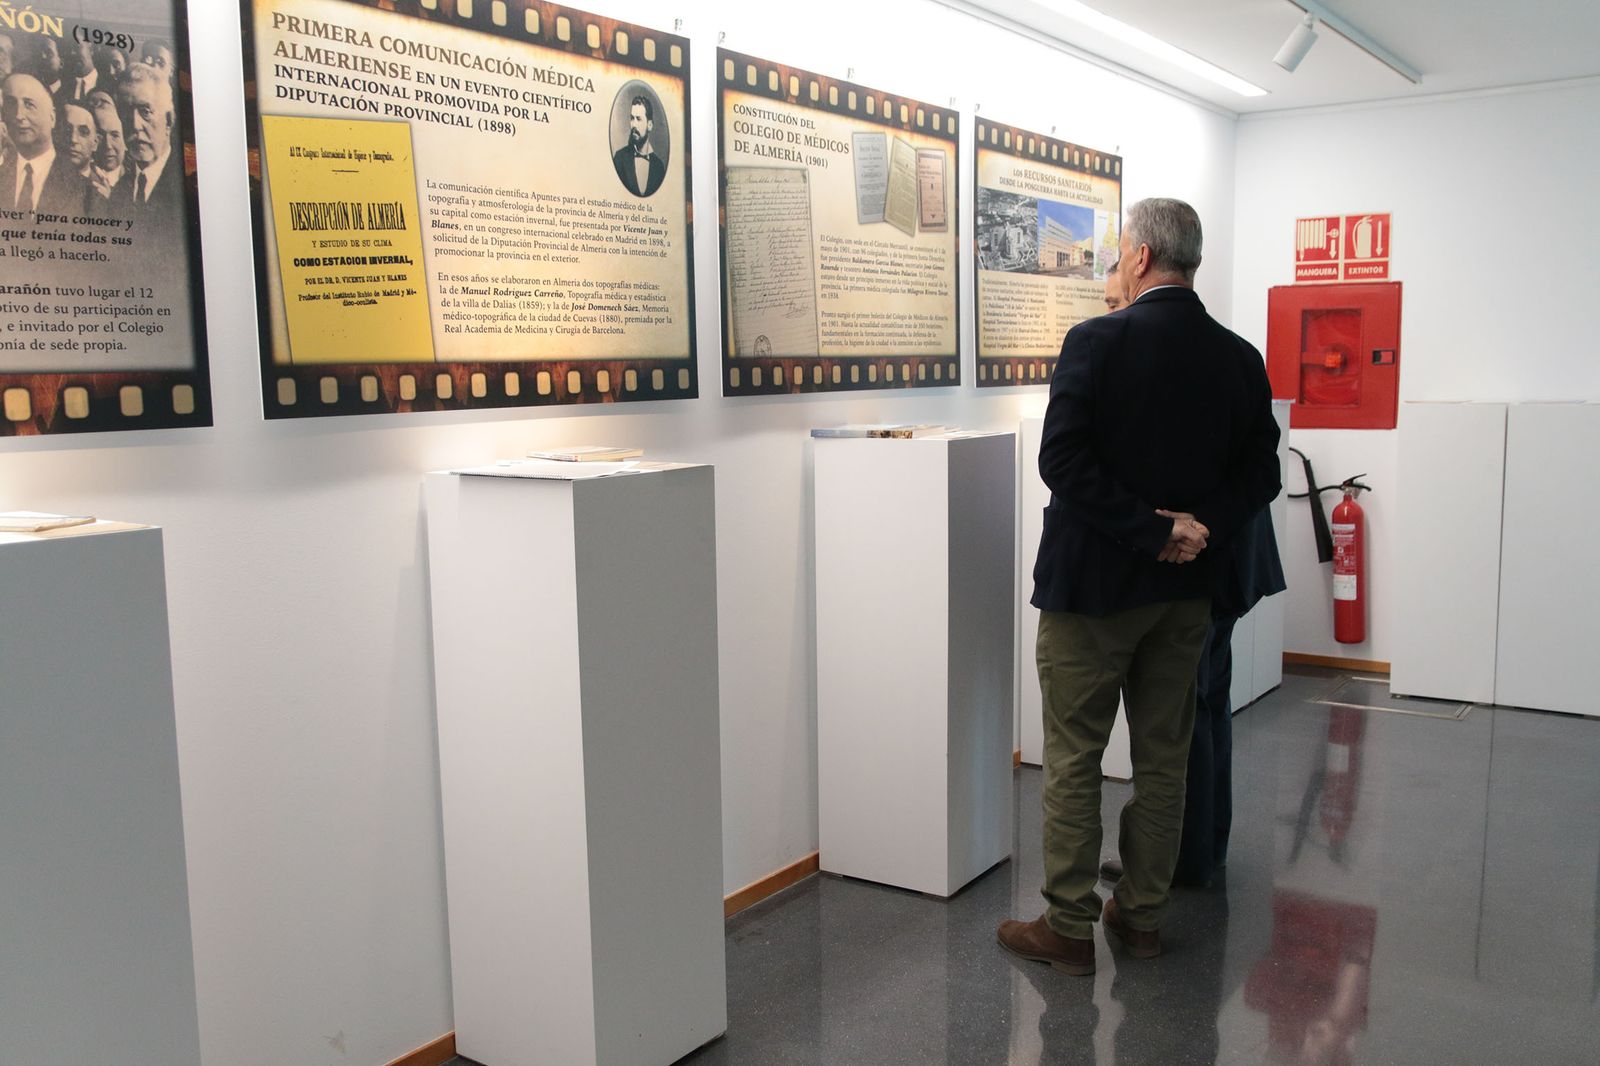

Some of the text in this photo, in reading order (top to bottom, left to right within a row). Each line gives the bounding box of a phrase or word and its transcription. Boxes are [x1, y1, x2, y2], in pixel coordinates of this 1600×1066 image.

[72, 24, 135, 53] (1928)
[271, 12, 595, 92] PRIMERA COMUNICACIÓN MÉDICA
[273, 41, 592, 113] ALMERIENSE EN UN EVENTO CIENTÍFICO
[274, 64, 549, 123] INTERNACIONAL PROMOVIDA POR LA
[275, 85, 516, 136] DIPUTACIÓN PROVINCIAL (1898)
[733, 103, 816, 130] CONSTITUCIÓN DEL
[734, 121, 784, 141] COLEGIO
[787, 130, 801, 144] DE
[804, 133, 850, 154] MÉDICOS
[734, 140, 828, 168] DE ALMERÍA (1901)
[1024, 169, 1056, 184] RECURSOS
[426, 178, 437, 189] La
[438, 182, 493, 195] comunicación
[530, 191, 561, 202] Apuntes
[561, 196, 578, 205] para
[586, 198, 612, 208] estudio
[71, 216, 122, 227] conocer
[124, 220, 133, 231] y
[289, 201, 406, 231] DESCRIPCIÓN DE ALMERÍA
[441, 208, 468, 219] capital
[470, 211, 492, 220] como
[493, 213, 525, 223] estación
[526, 214, 558, 227] invernal,
[559, 217, 570, 227] fue
[571, 221, 609, 230] presentada
[609, 224, 621, 233] por
[623, 224, 647, 234] Vicente
[647, 226, 663, 236] Juan
[554, 207, 587, 217] provincia
[630, 213, 641, 222] del
[641, 214, 659, 224] clima
[1, 229, 132, 245] que tenía todas sus
[431, 219, 665, 247] Blanes, congreso internacional celebrado Madrid 1898,
[432, 232, 468, 243] solicitud
[490, 236, 532, 248] Diputación
[533, 240, 569, 251] Provincial
[10, 245, 44, 261] llegó
[59, 247, 110, 262] hacerlo.
[434, 247, 579, 263] promocionar provincia exterior.
[1297, 268, 1337, 276] MANGUERA
[1348, 266, 1384, 275] EXTINTOR
[437, 271, 660, 290] En esos años elaboraron dos médicas:
[55, 287, 85, 296] tuvo
[88, 285, 121, 300] lugar
[123, 286, 135, 298] el
[139, 287, 153, 298] 12
[460, 286, 491, 295] Manuel
[533, 288, 566, 298] Carreño,
[0, 301, 171, 318] tivo de su participación en
[461, 298, 479, 308] villa
[570, 302, 586, 312] José
[641, 304, 669, 313] Memoria
[537, 312, 561, 322] ciudad
[572, 313, 597, 322] Cuevas
[623, 314, 653, 325] premiada
[19, 319, 74, 332] invitado
[77, 323, 99, 335] por
[102, 321, 114, 333] el
[117, 321, 164, 336] Colegio
[444, 323, 626, 334] Real Academia Medicina Barcelona.
[29, 338, 46, 350] de
[50, 338, 79, 350] sede
[82, 339, 127, 353] propia.
